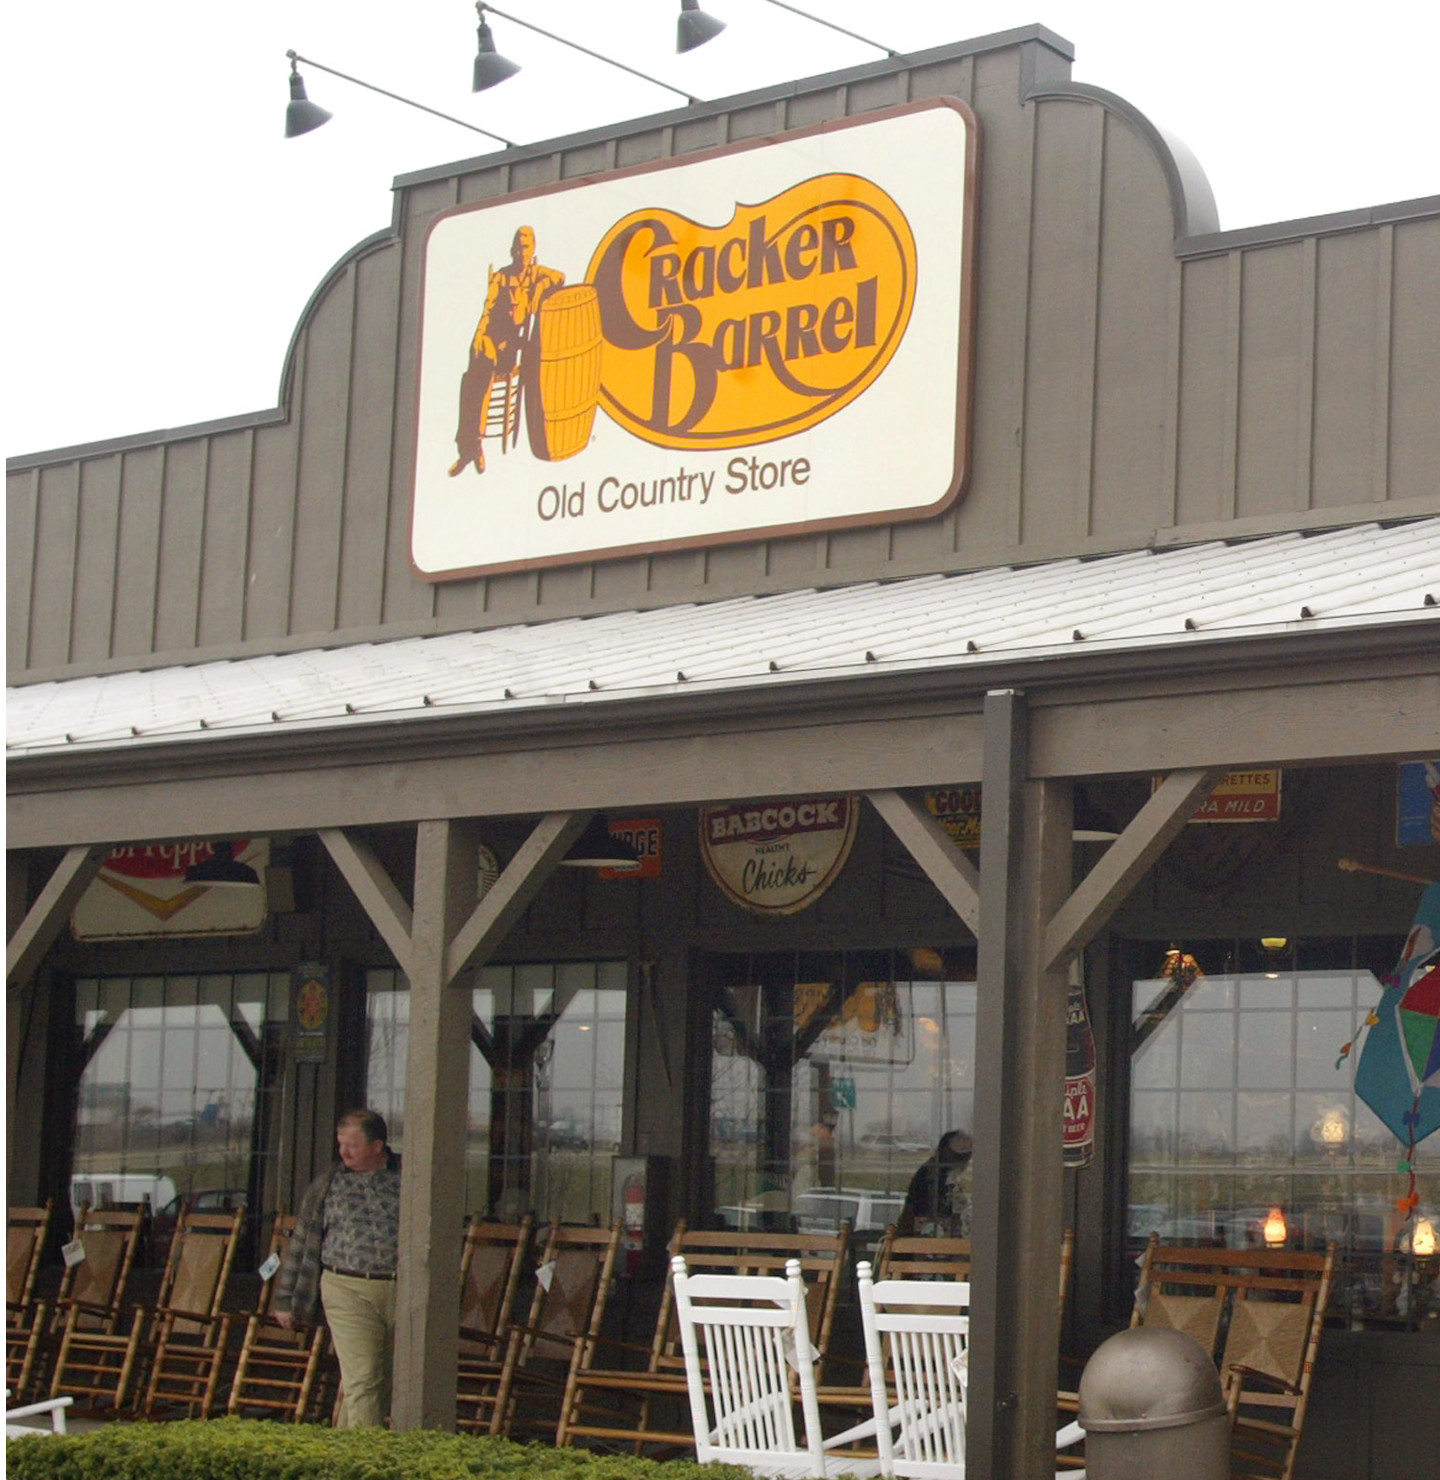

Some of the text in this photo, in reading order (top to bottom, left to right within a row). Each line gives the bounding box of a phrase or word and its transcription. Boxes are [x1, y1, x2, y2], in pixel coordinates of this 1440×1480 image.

[600, 215, 858, 351] Cracker
[652, 275, 878, 434] Barrel
[537, 457, 811, 522] Old Country Store
[1222, 774, 1270, 786] RETTES
[711, 802, 839, 838] BABCOCK
[1225, 799, 1265, 812] MILD
[742, 856, 816, 894] Chicks
